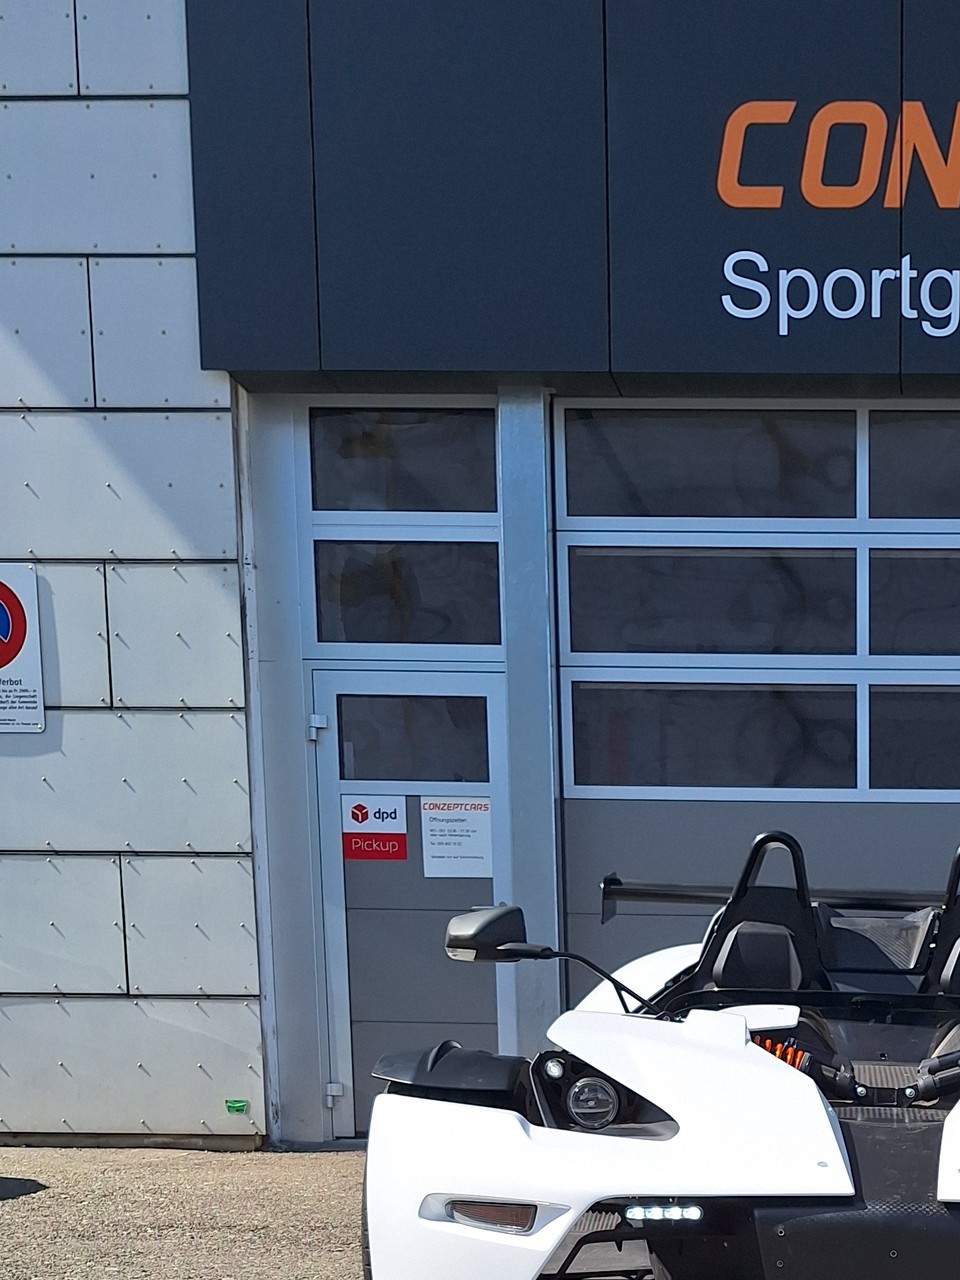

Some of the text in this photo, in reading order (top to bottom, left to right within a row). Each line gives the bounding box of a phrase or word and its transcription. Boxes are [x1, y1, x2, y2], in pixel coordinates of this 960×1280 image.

[373, 807, 397, 822] dpd
[422, 802, 490, 812] CONZEPTCARS
[351, 838, 399, 853] Pickup
